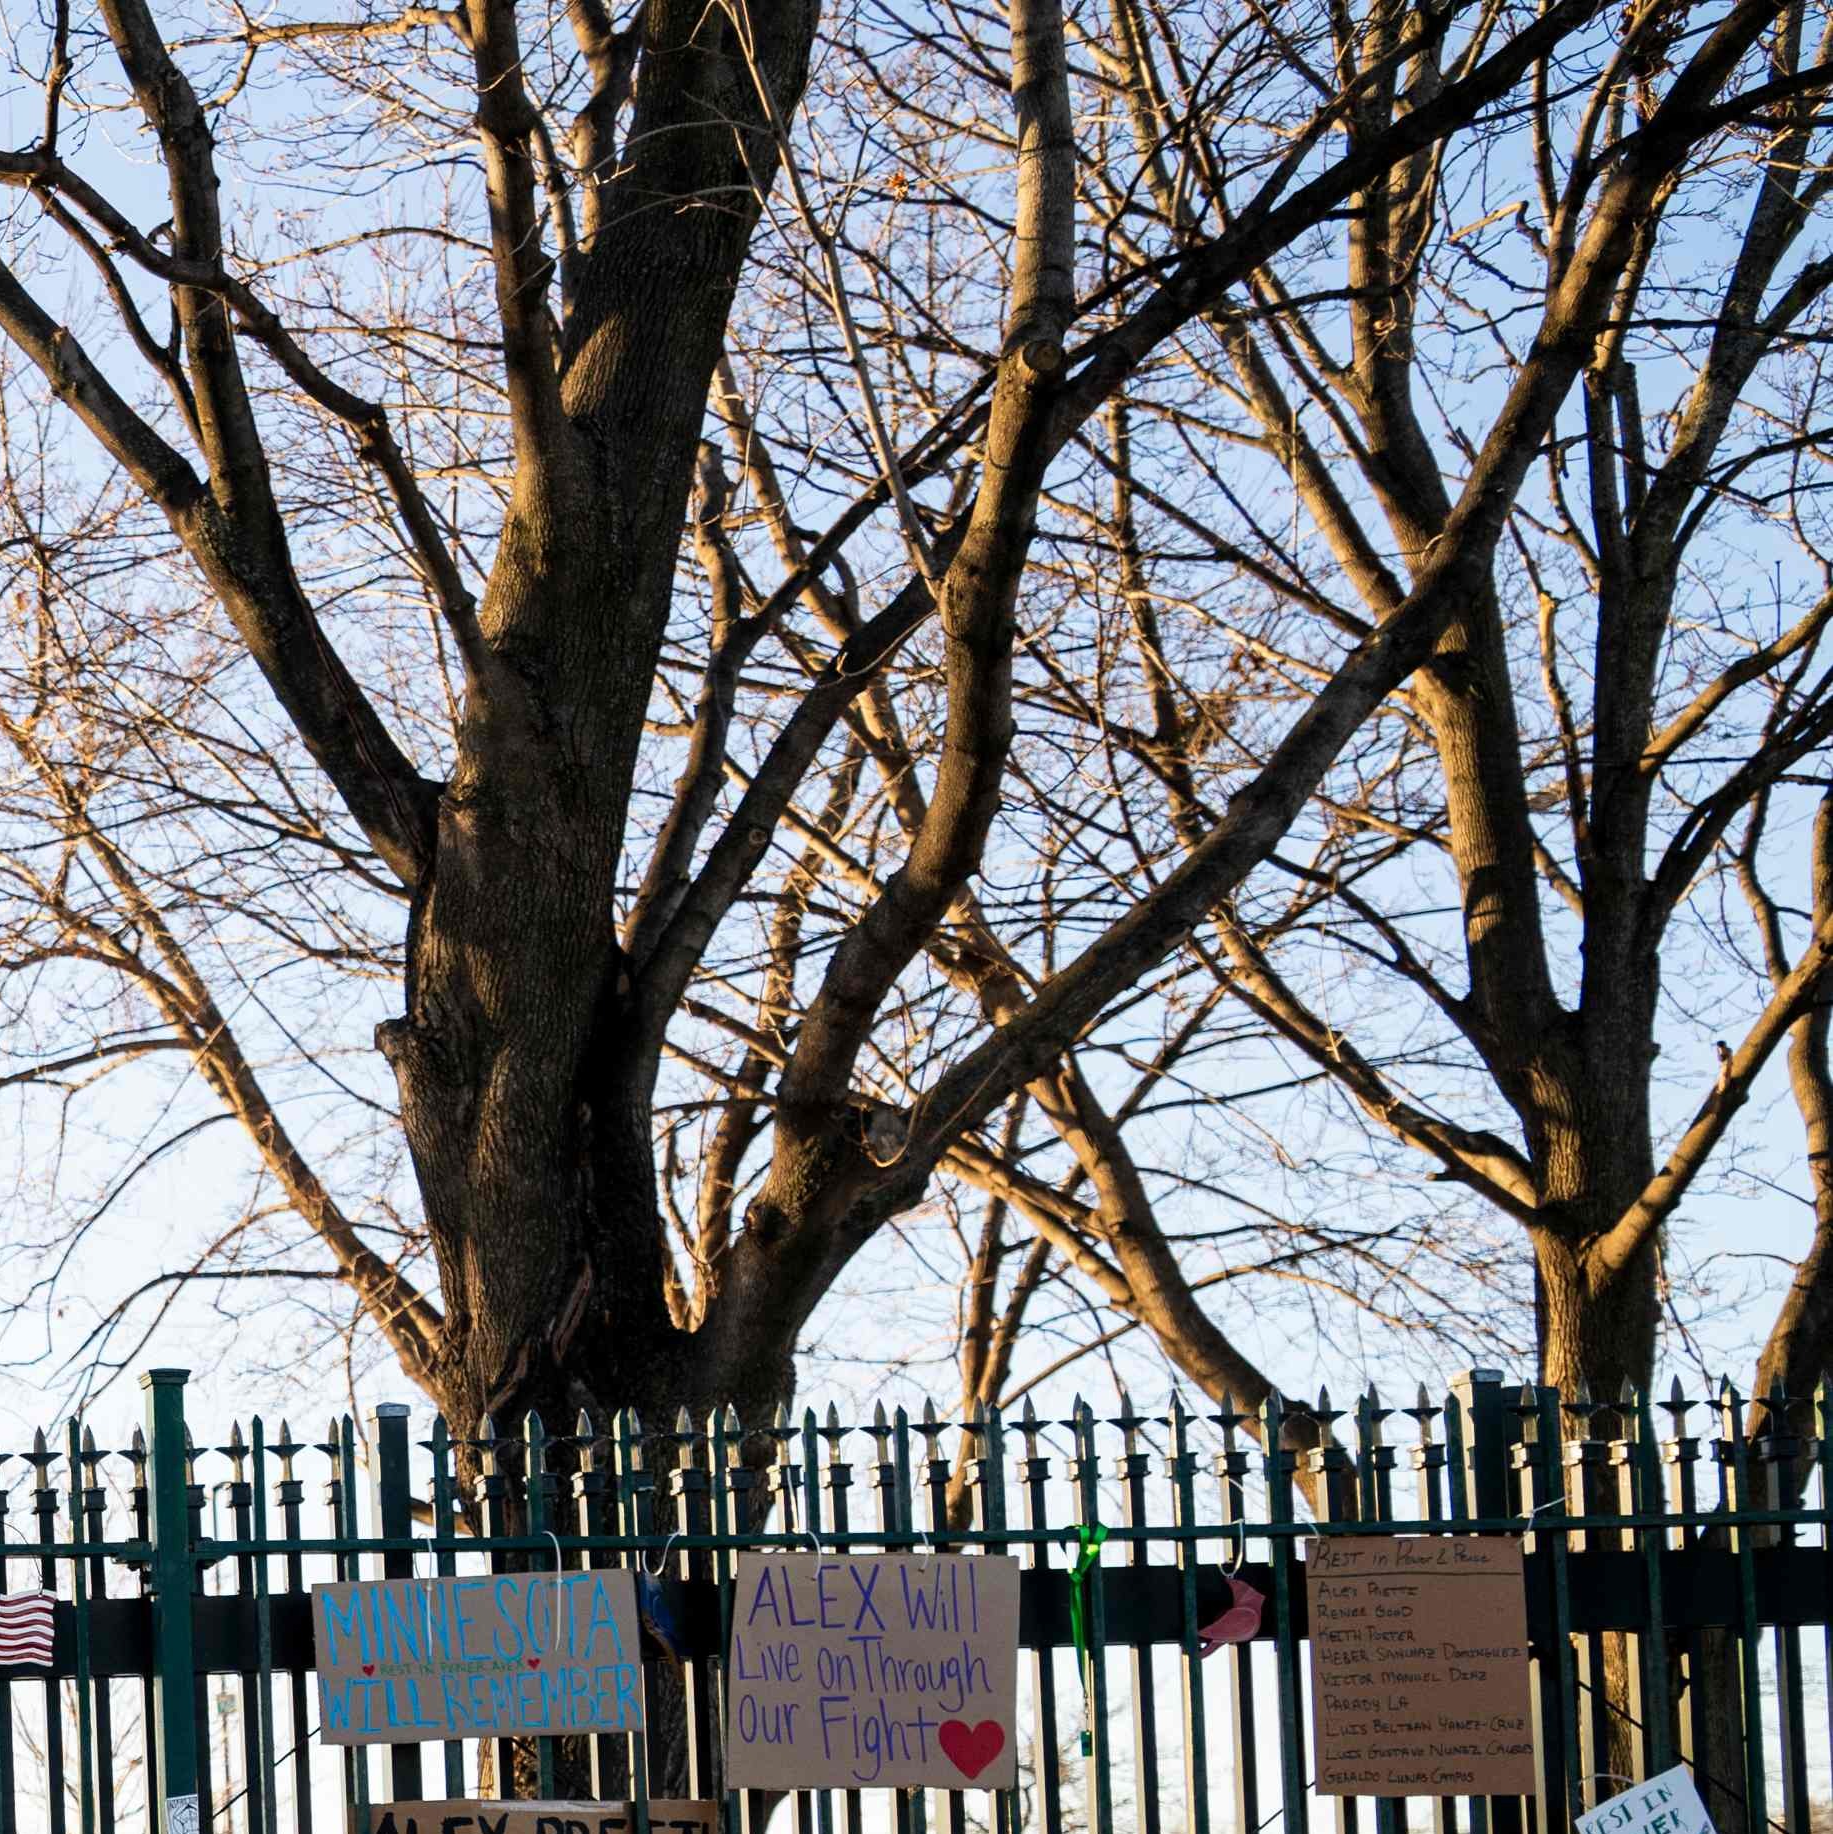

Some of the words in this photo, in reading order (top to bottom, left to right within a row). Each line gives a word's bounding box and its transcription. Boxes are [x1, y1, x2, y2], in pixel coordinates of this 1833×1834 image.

[321, 1573, 624, 1667] MINNESOTA
[748, 1564, 886, 1632] ALEX
[899, 1562, 978, 1633] Will
[323, 1677, 441, 1733] WILL
[442, 1662, 642, 1733] REMEMBER
[735, 1634, 803, 1682] Live
[847, 1635, 993, 1713] Through
[738, 1694, 800, 1744] Our
[819, 1696, 940, 1782] Fight
[1640, 1783, 1674, 1814] IN
